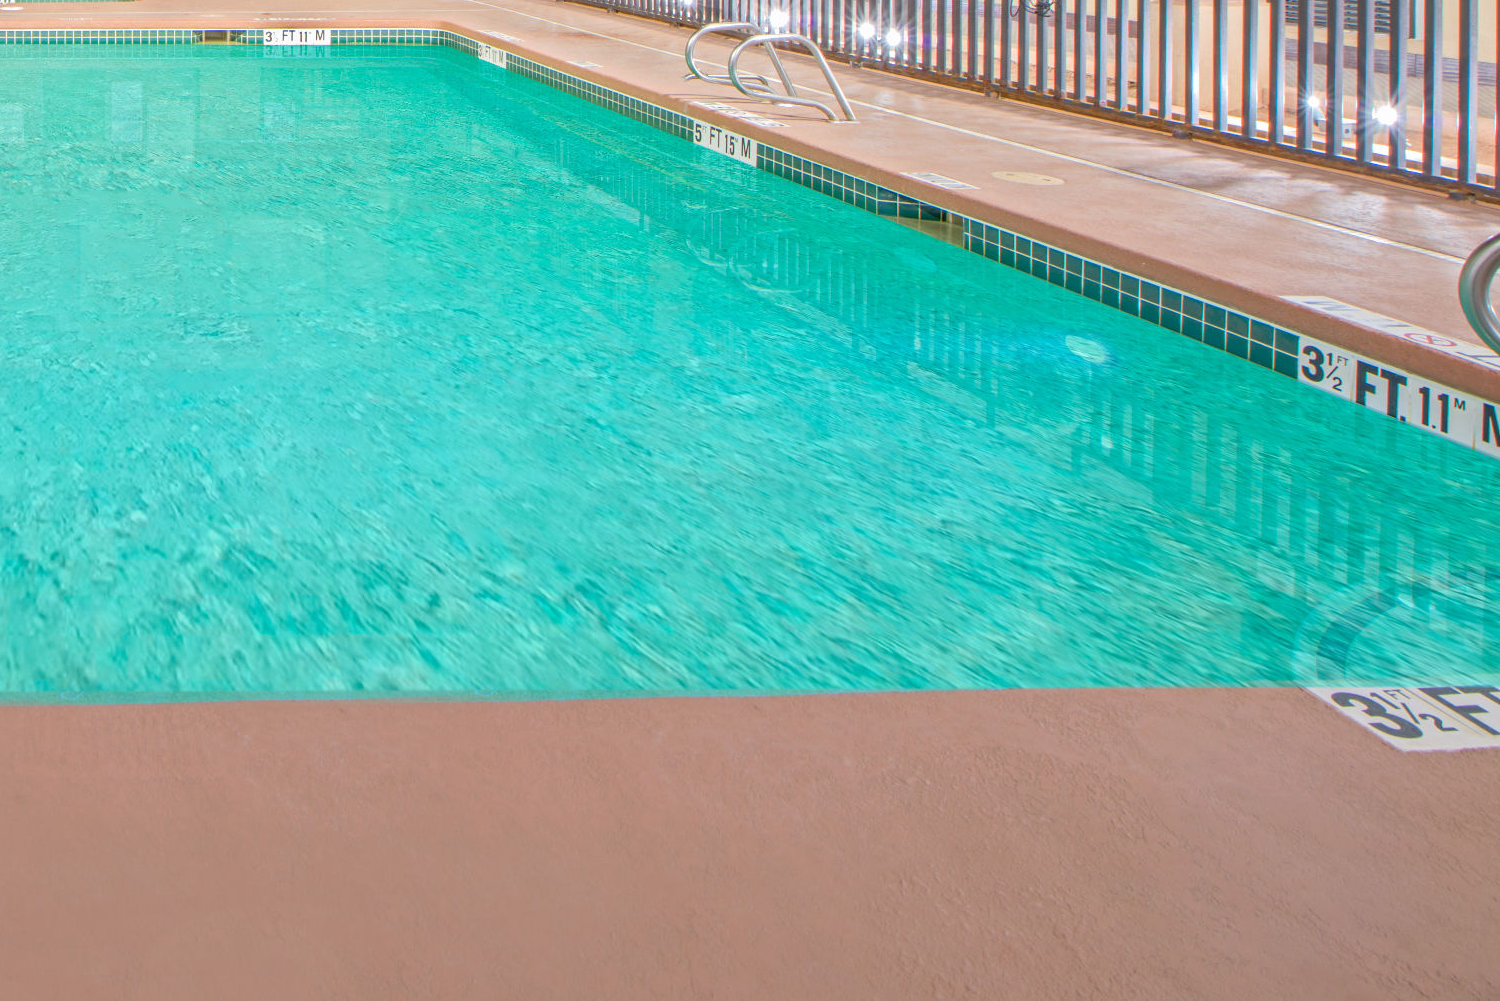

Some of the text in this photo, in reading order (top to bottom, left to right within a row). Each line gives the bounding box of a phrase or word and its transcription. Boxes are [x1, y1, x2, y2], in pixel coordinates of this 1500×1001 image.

[282, 30, 295, 41] FT
[315, 30, 325, 41] M
[695, 123, 702, 143] 5
[709, 126, 722, 148] FT
[741, 137, 751, 159] M
